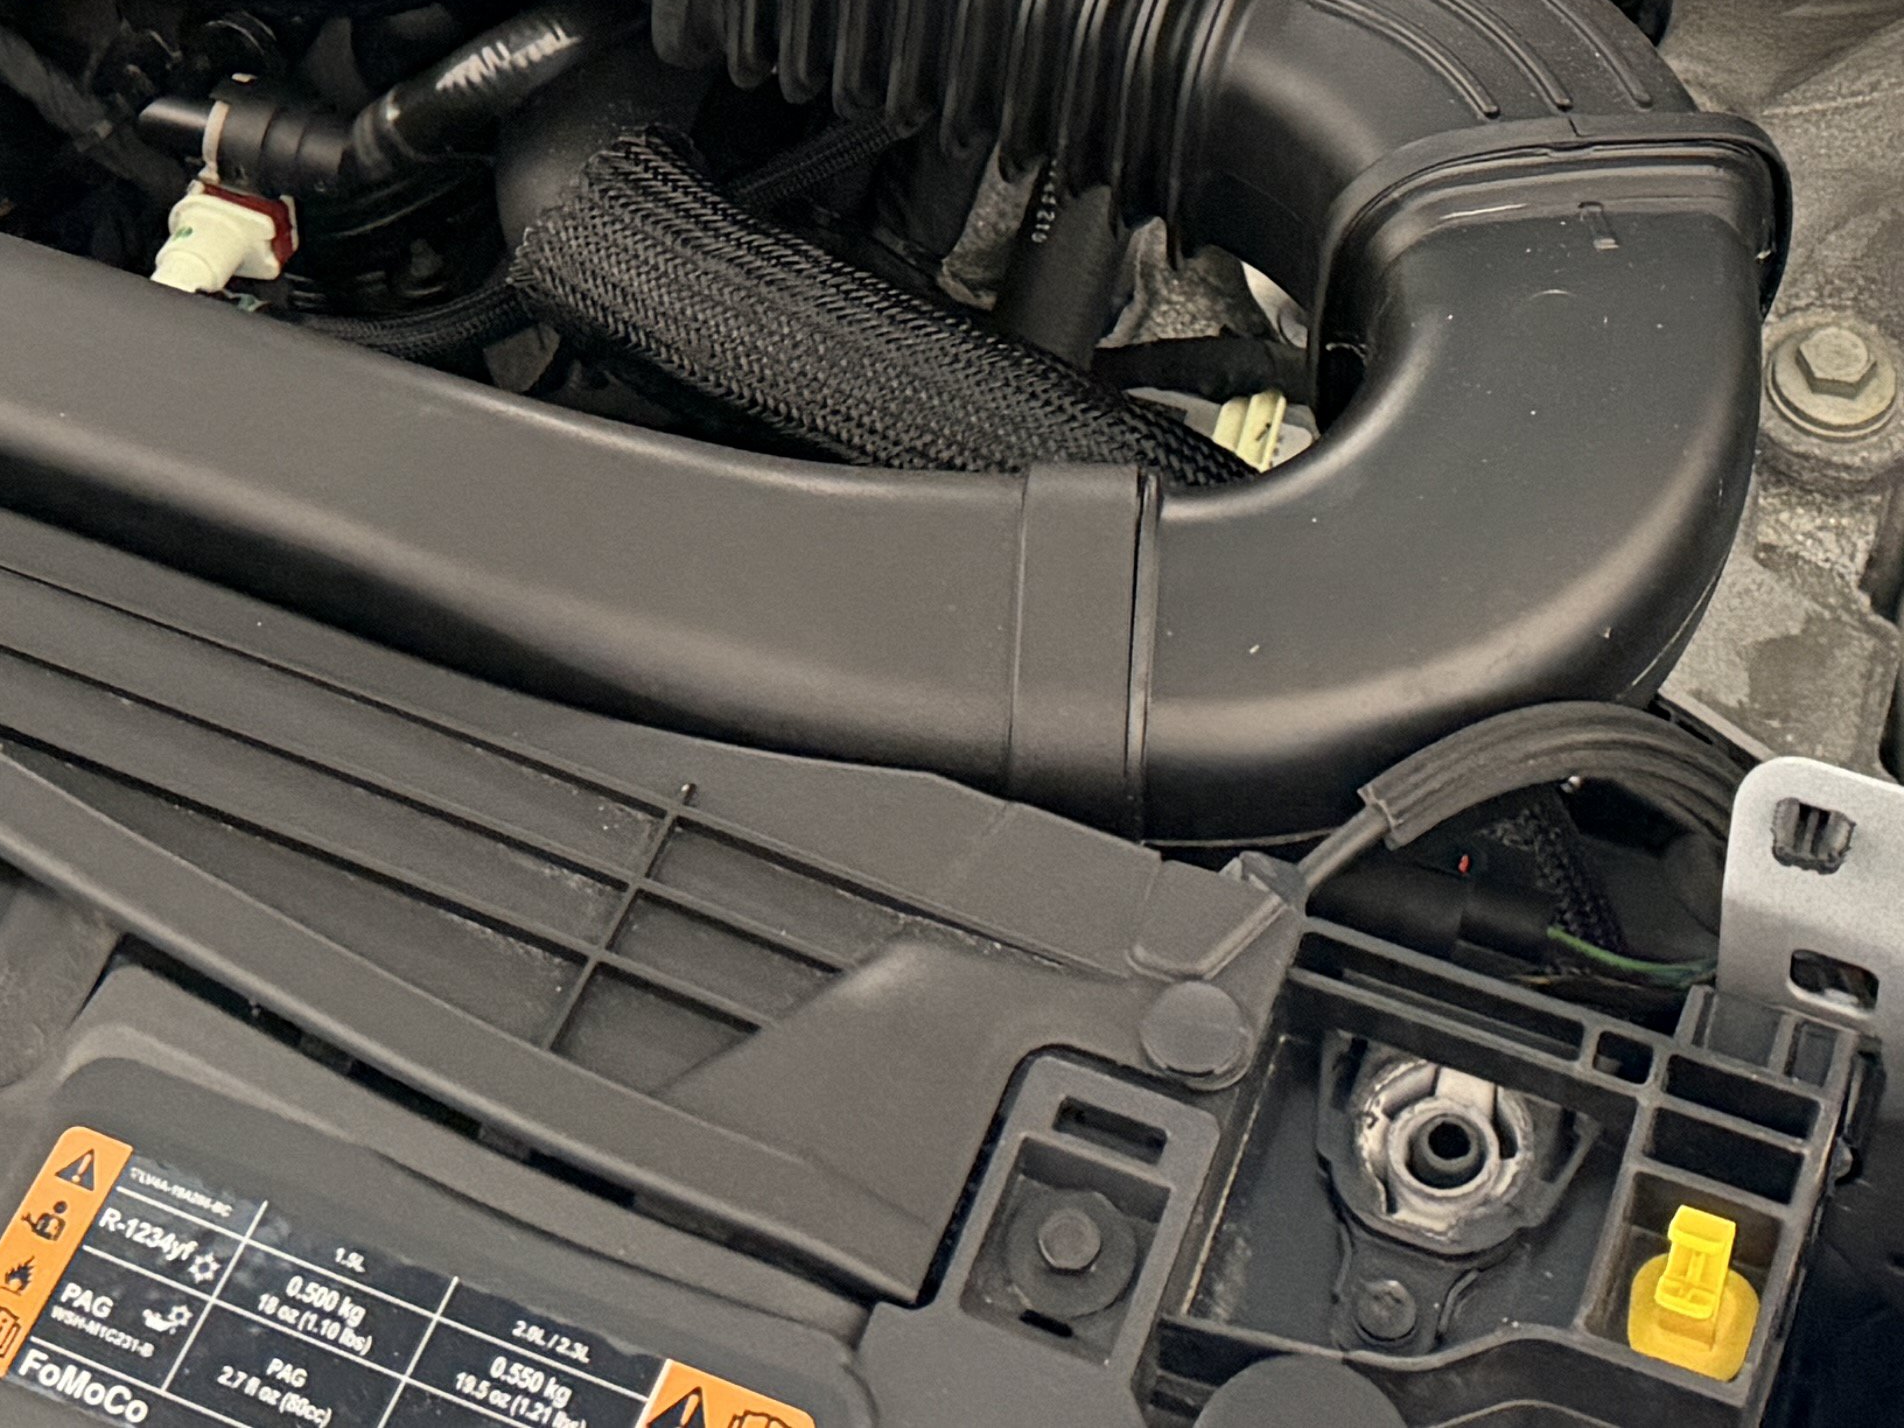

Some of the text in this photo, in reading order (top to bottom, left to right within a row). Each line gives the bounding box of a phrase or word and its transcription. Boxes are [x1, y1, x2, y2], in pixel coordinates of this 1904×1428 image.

[98, 1207, 200, 1262] R-1234yf
[60, 1281, 115, 1319] PAG
[256, 1292, 279, 1316] 18
[277, 1305, 299, 1327] oz
[339, 1325, 374, 1357] lbs)
[285, 1275, 367, 1328] 0.500 kg
[18, 1348, 150, 1425] FoMoCo
[259, 1384, 281, 1407] oz
[265, 1357, 309, 1389] PAG
[488, 1356, 574, 1410] 0.550 kg
[488, 1386, 512, 1410] oz
